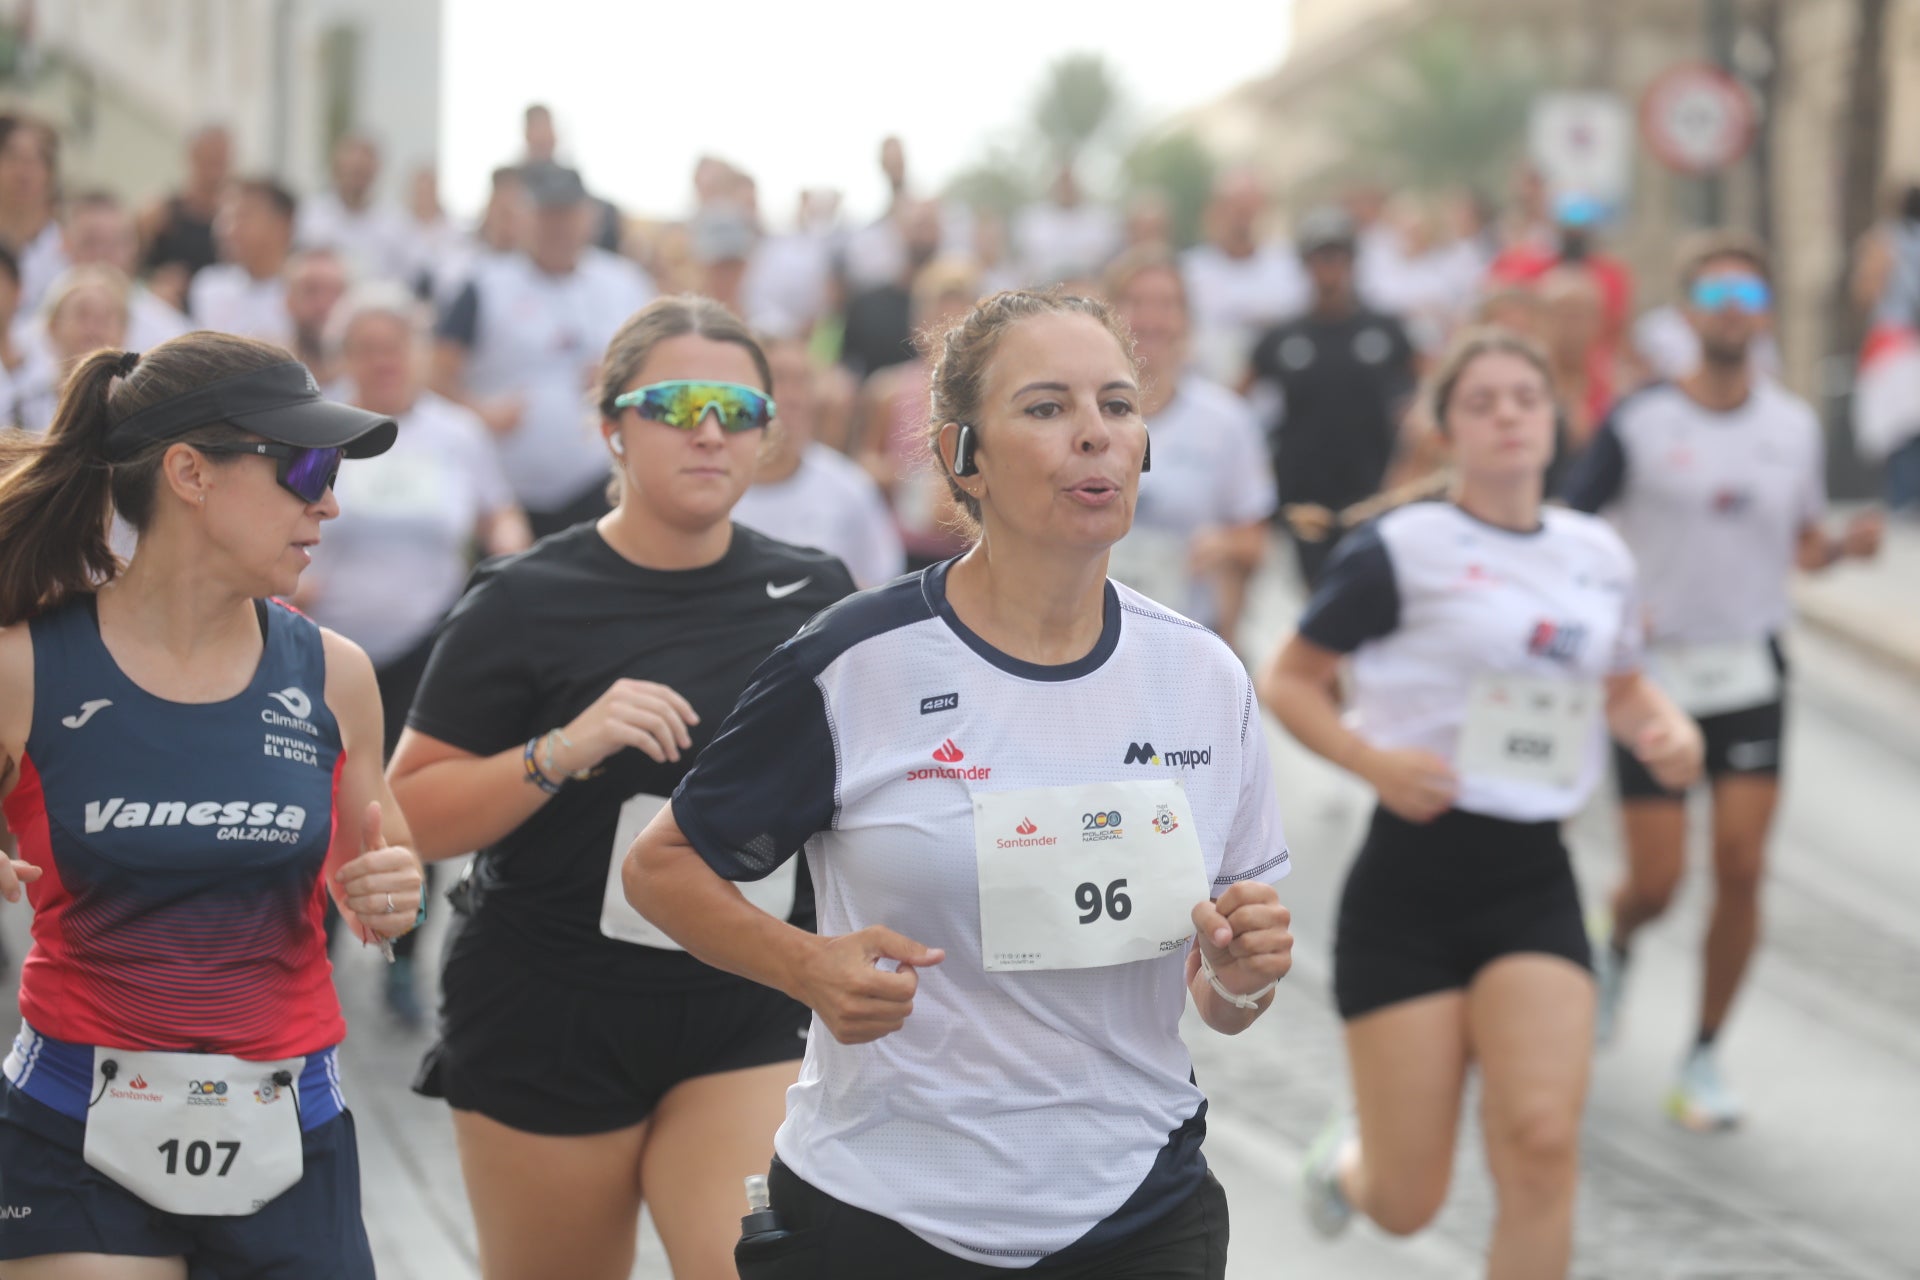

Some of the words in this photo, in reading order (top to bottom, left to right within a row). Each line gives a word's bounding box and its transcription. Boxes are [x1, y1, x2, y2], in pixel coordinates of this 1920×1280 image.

[922, 696, 956, 711] 42K
[261, 709, 318, 736] Climatiza
[264, 743, 280, 757] EL
[284, 747, 317, 767] BOLA
[1164, 745, 1211, 769] mupol
[906, 765, 991, 781] Santander
[85, 797, 306, 834] Vanessa
[217, 827, 299, 844] CALZADOS
[996, 836, 1057, 849] Santander
[1074, 878, 1132, 925] 96
[109, 1088, 163, 1103] Santander
[157, 1139, 241, 1177] 107
